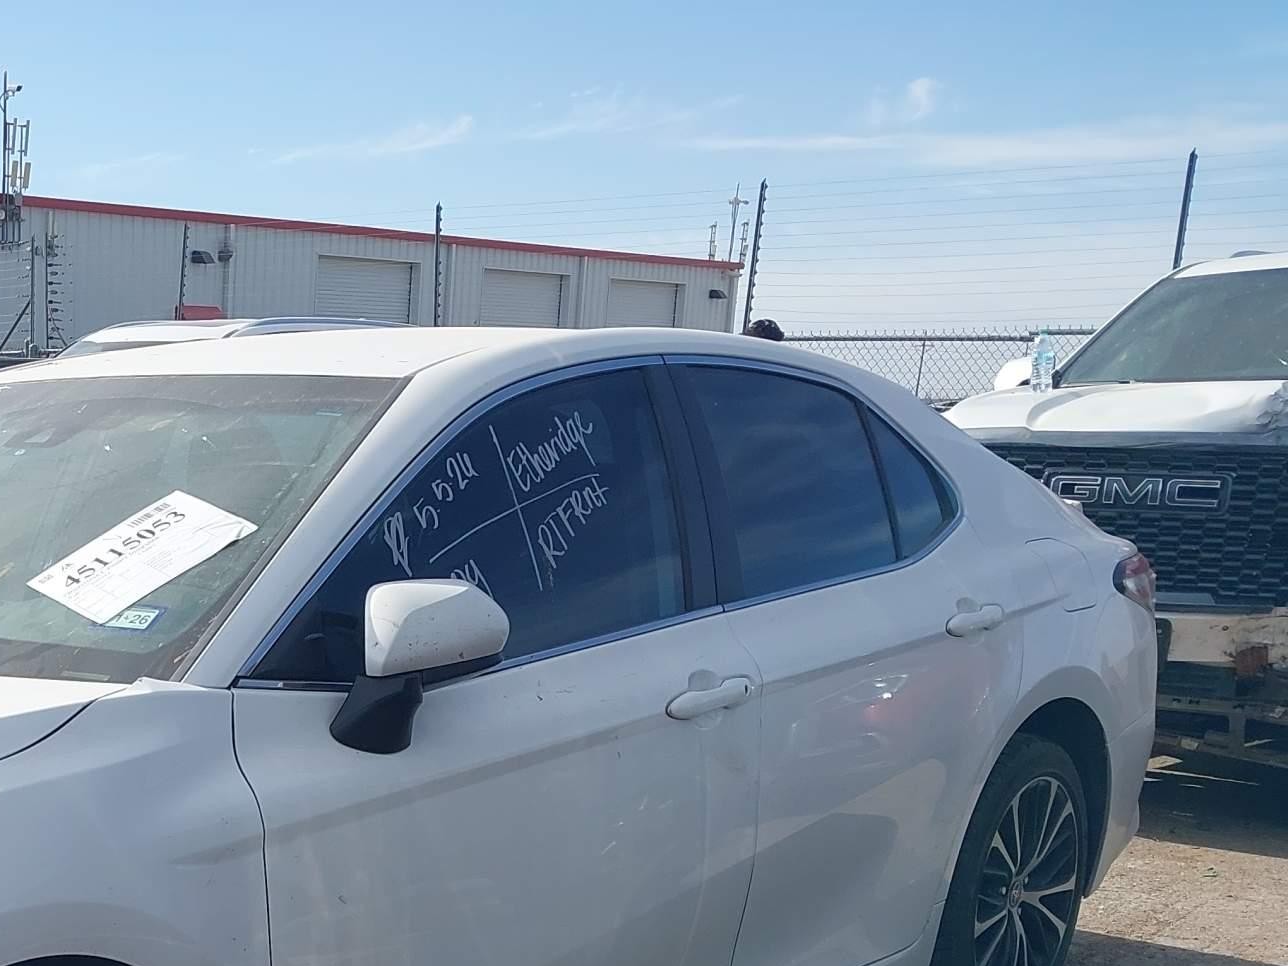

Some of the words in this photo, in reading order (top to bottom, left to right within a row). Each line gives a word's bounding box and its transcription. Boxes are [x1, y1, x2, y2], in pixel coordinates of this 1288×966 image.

[507, 411, 595, 492] Etheridge
[1050, 475, 1222, 508] GMC
[65, 511, 186, 587] 45115053
[128, 614, 152, 625] 26
